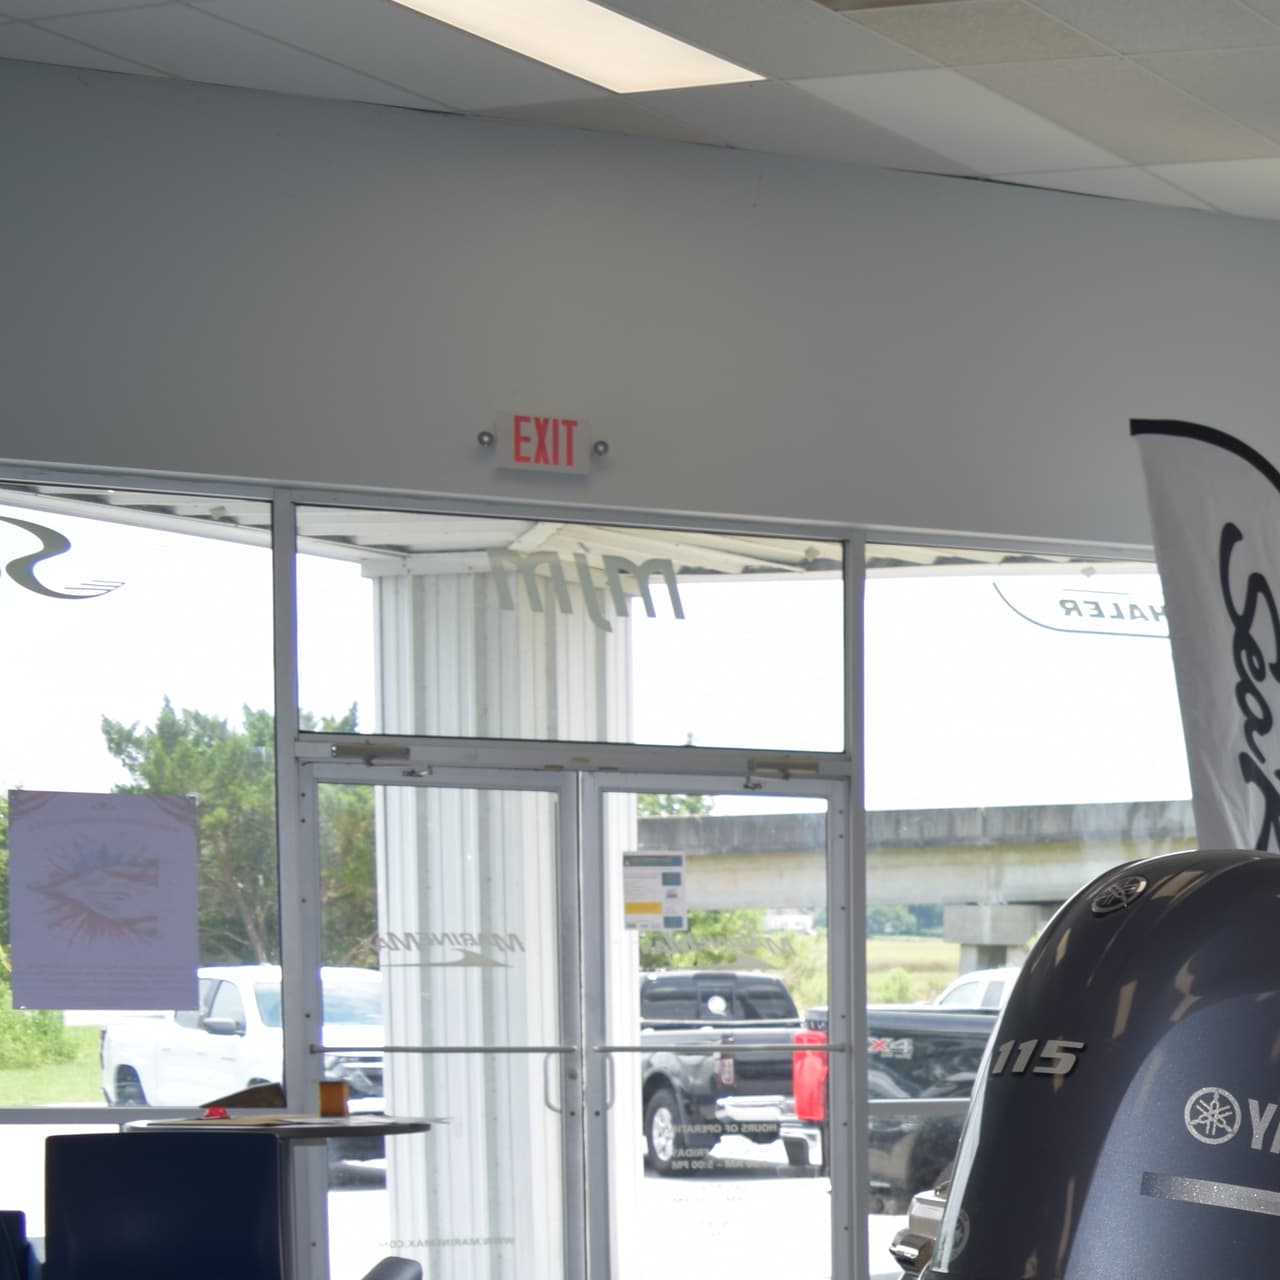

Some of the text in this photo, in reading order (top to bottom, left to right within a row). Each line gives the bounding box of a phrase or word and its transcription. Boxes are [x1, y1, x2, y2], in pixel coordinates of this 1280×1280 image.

[513, 415, 578, 467] EXIT
[868, 1037, 914, 1053] X4
[992, 1039, 1085, 1075] 115
